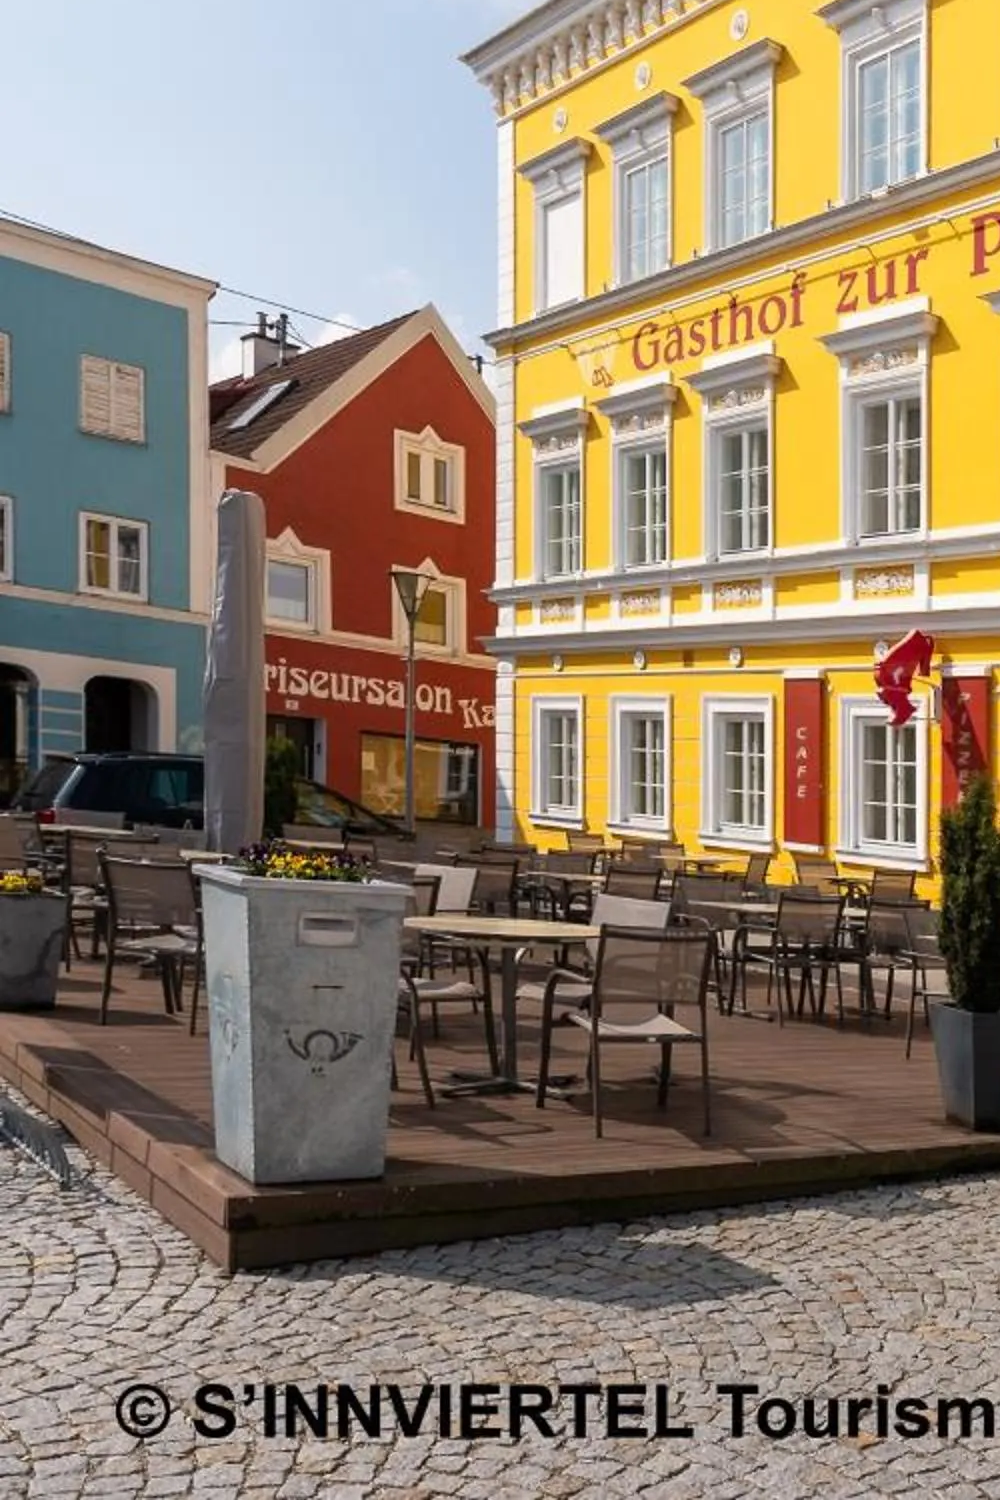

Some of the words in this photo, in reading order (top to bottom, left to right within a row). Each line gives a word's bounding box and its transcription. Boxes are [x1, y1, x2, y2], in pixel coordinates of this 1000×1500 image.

[631, 272, 807, 372] Gasthof
[836, 245, 930, 313] zur
[264, 657, 453, 714] riseursaon
[795, 726, 808, 799] CAFE
